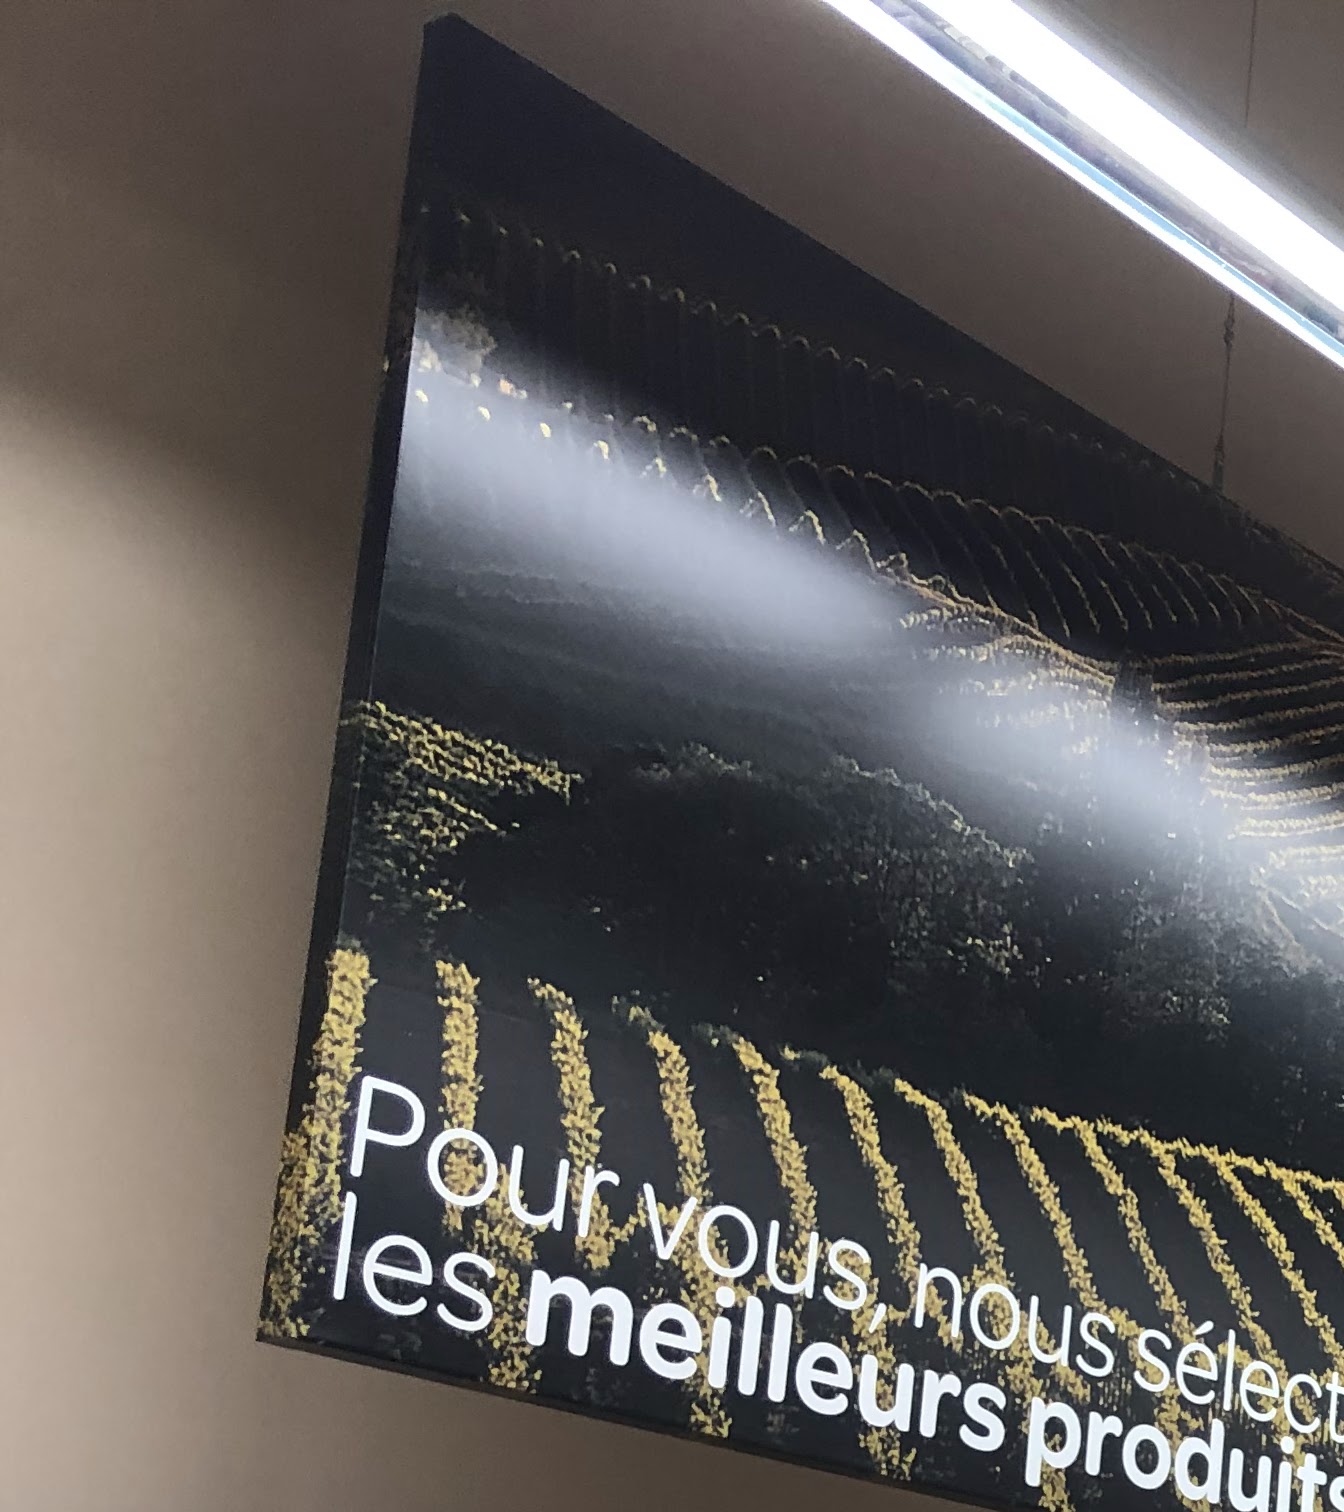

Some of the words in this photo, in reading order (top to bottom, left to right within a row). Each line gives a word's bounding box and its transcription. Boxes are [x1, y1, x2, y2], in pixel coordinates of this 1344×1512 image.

[332, 1191, 494, 1333] les
[525, 1268, 1005, 1452] meilleurs
[349, 1075, 620, 1242] Pour
[643, 1183, 888, 1334] vous,
[914, 1262, 1115, 1377] nous
